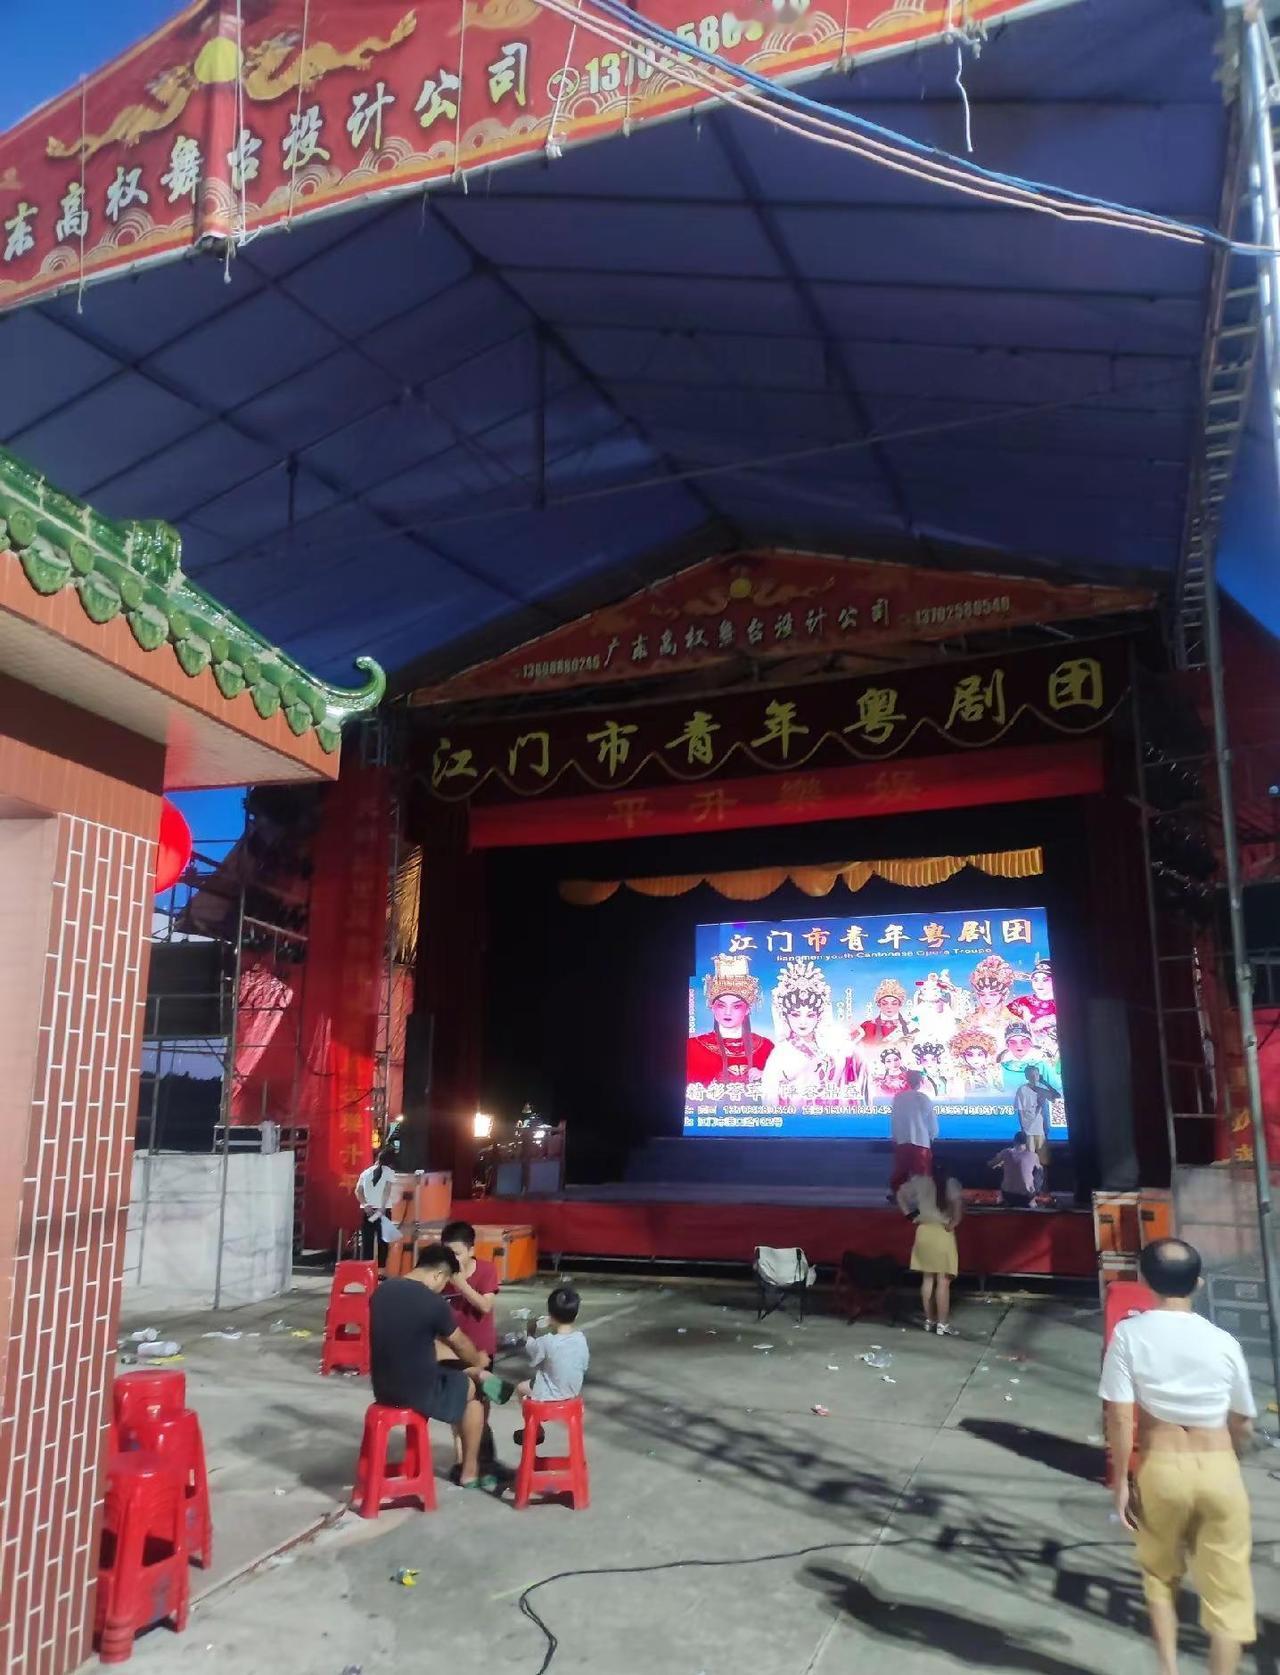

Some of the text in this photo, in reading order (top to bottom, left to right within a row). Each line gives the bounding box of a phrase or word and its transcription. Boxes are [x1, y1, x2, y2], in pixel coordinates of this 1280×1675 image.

[432, 657, 1104, 788] 江门市青年粤剧团
[729, 918, 1032, 953] 江门市青年粤剧团
